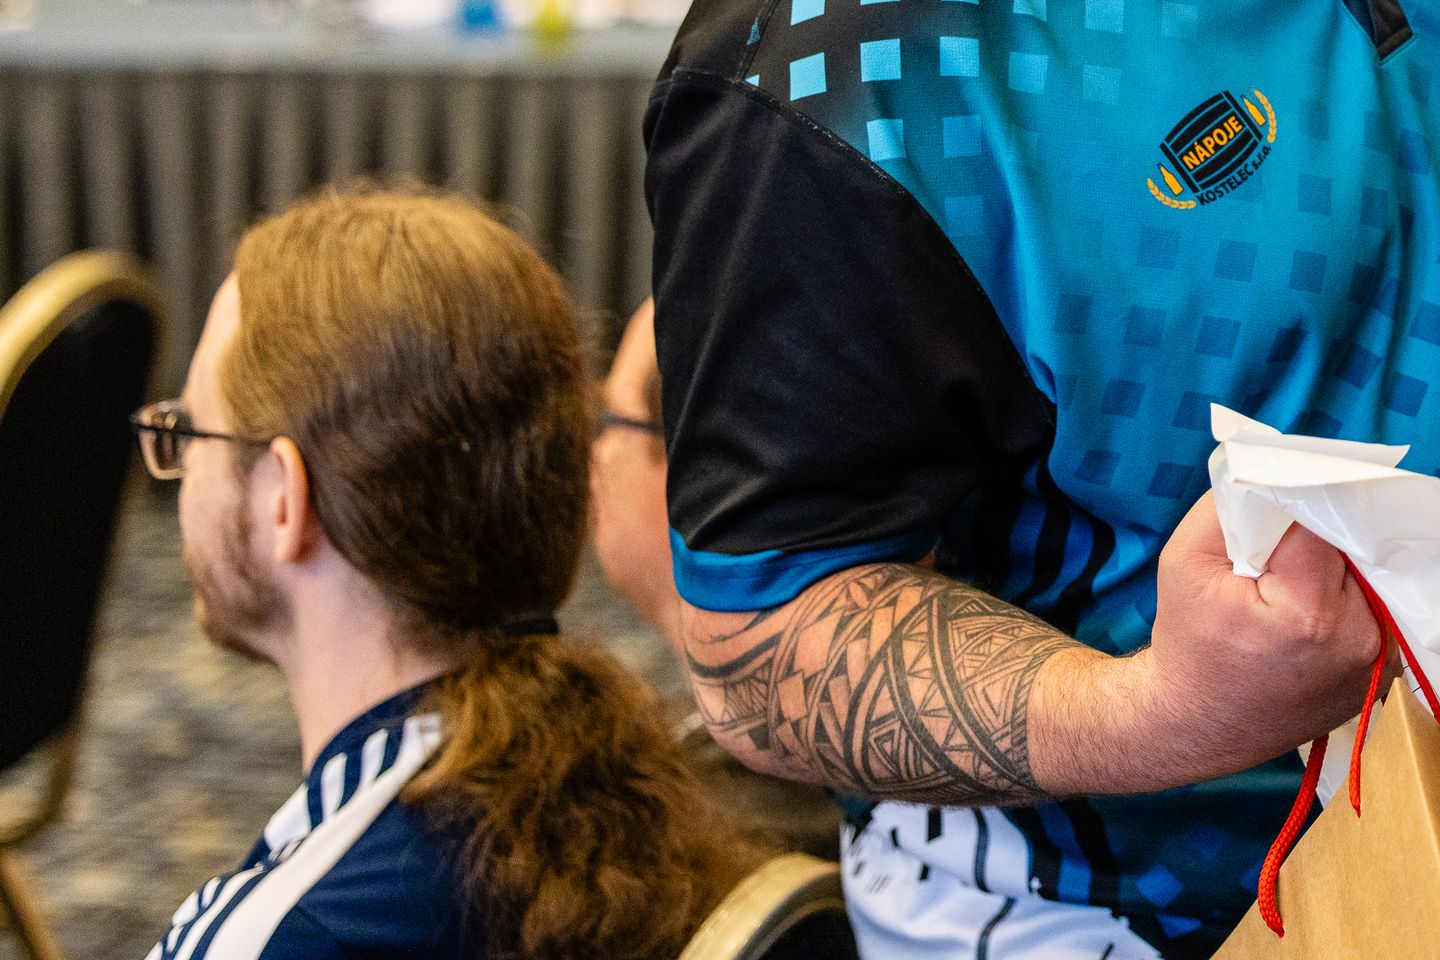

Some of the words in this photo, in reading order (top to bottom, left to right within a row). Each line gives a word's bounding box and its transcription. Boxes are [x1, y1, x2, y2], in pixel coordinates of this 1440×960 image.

[1182, 115, 1243, 170] NÁPOJE
[1196, 162, 1254, 207] KOSTELEC
[1251, 144, 1272, 171] s.r.o.
